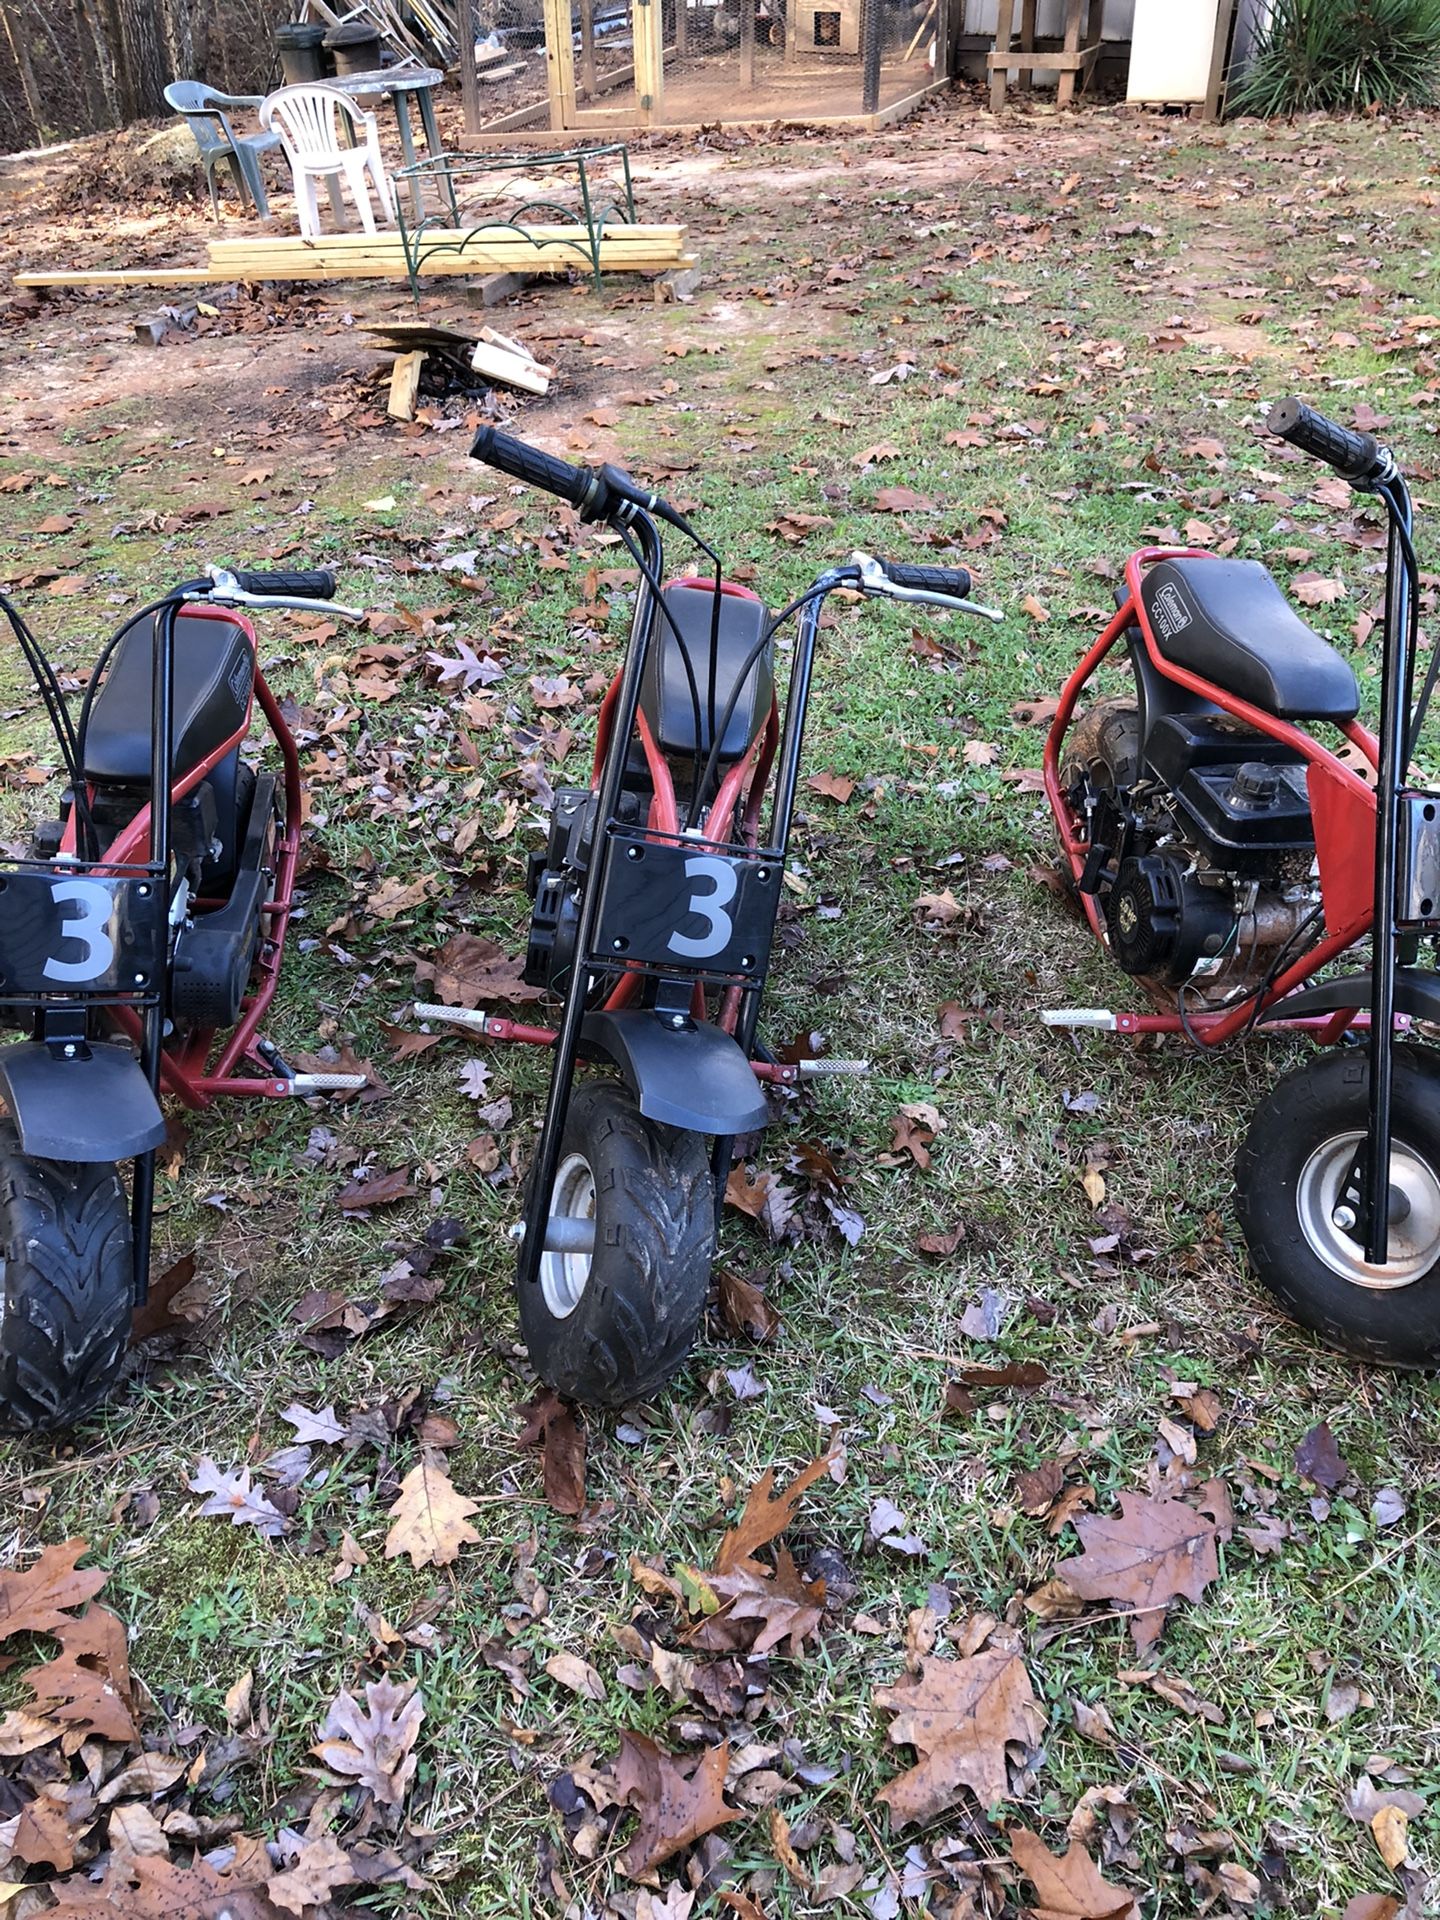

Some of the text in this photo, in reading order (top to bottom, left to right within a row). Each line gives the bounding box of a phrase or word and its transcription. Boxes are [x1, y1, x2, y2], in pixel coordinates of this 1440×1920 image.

[1151, 602, 1173, 642] CC100X
[1161, 587, 1185, 623] Coleman
[43, 881, 114, 982] 3
[667, 858, 737, 958] 3
